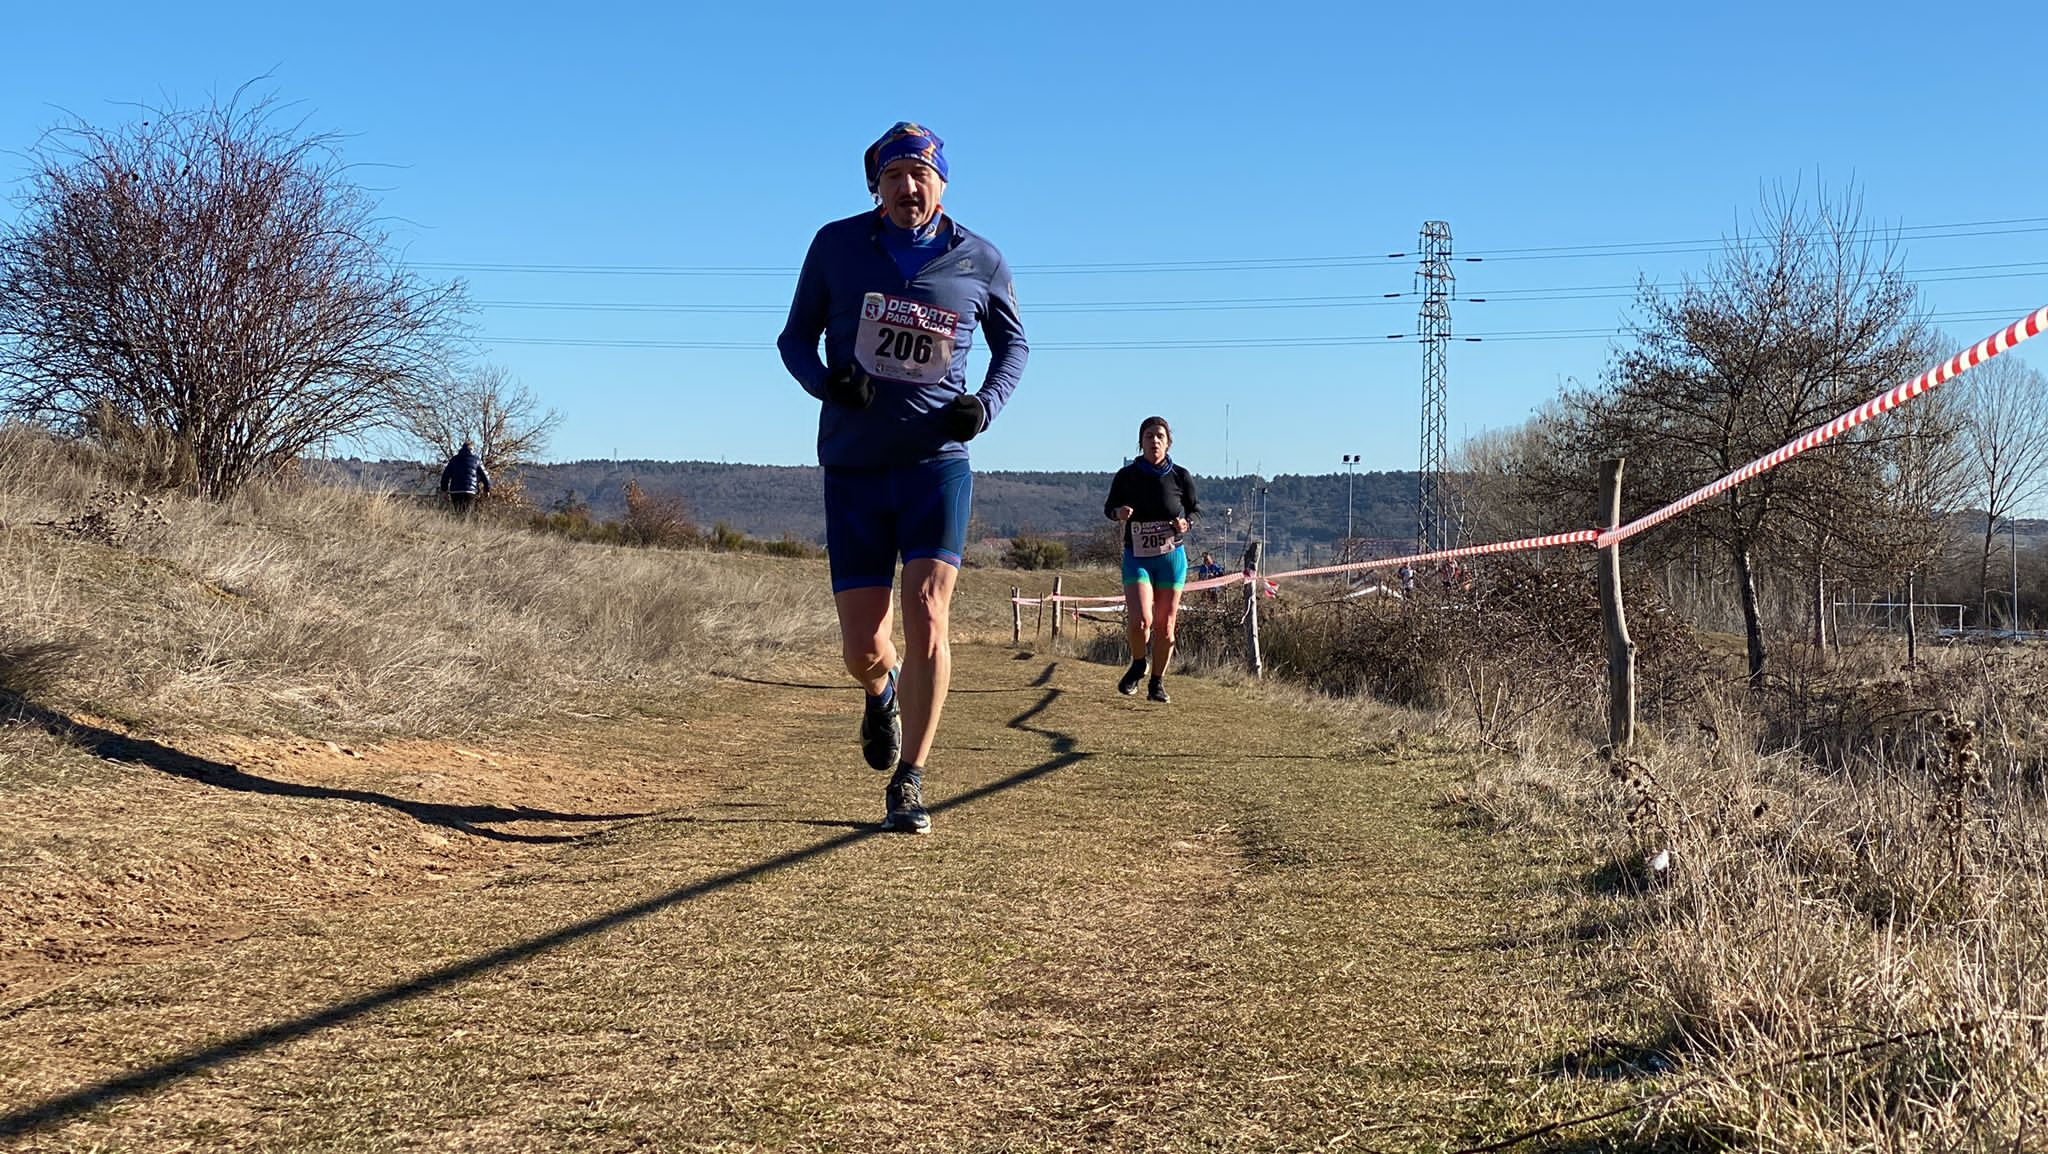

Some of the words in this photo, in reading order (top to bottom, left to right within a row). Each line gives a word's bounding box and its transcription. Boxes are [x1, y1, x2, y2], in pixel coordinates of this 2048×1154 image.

[886, 312, 914, 326] PARA
[917, 318, 952, 336] TODOS
[887, 299, 957, 325] DEPORTE
[875, 328, 933, 364] 206
[1142, 535, 1166, 549] 205
